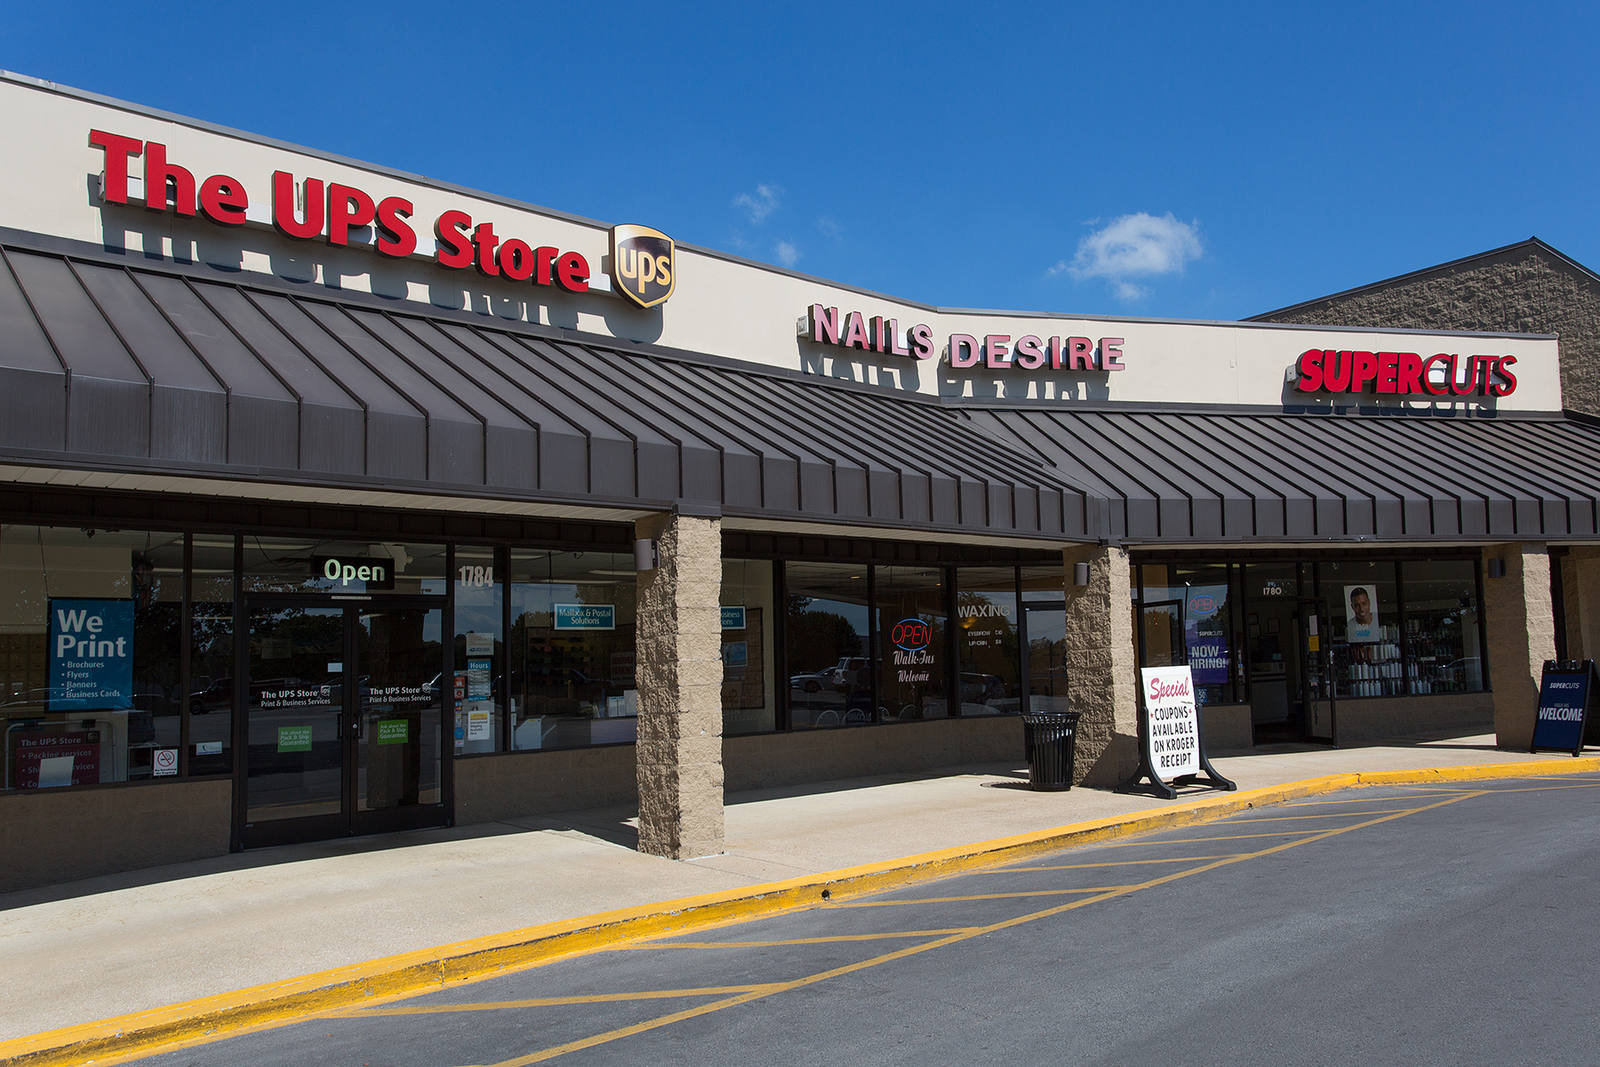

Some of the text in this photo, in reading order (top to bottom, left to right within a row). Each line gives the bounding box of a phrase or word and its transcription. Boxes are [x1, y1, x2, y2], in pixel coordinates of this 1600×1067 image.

[88, 129, 590, 292] The UPS Store
[618, 247, 672, 294] ups
[808, 303, 1126, 371] NAILS DESIRE
[1295, 348, 1518, 397] SUPERCUTS
[323, 558, 386, 586] Open
[458, 565, 494, 588] 1784
[1263, 586, 1283, 596] 1780
[558, 607, 612, 617] Mailbox & Postal
[957, 603, 1010, 618] WAXING
[57, 608, 104, 633] We
[570, 616, 600, 625] Solutions
[891, 624, 933, 645] OPEN
[56, 633, 127, 658] Print
[1191, 645, 1219, 658] NOW
[66, 660, 105, 669] Brochures
[470, 662, 489, 670] Hours
[1188, 658, 1226, 670] HIRING!
[66, 670, 89, 680] Flyers
[897, 669, 930, 683] Welcome
[66, 680, 97, 689] Banners
[369, 686, 420, 696] The UPS Store
[1150, 676, 1190, 703] Special
[65, 689, 121, 698] Business Cards
[260, 689, 318, 699] The UPS Store
[410, 694, 432, 702] Services
[260, 700, 276, 708] Print
[276, 699, 281, 707] &
[307, 698, 331, 706] Services
[1154, 706, 1189, 721] COUPONS
[1538, 706, 1584, 721] WELCOME
[1152, 721, 1193, 737] AVAILABLE
[20, 736, 82, 747] The UPS Store
[1154, 736, 1195, 753] ON KROGER
[1160, 752, 1192, 768] RECEIPT
